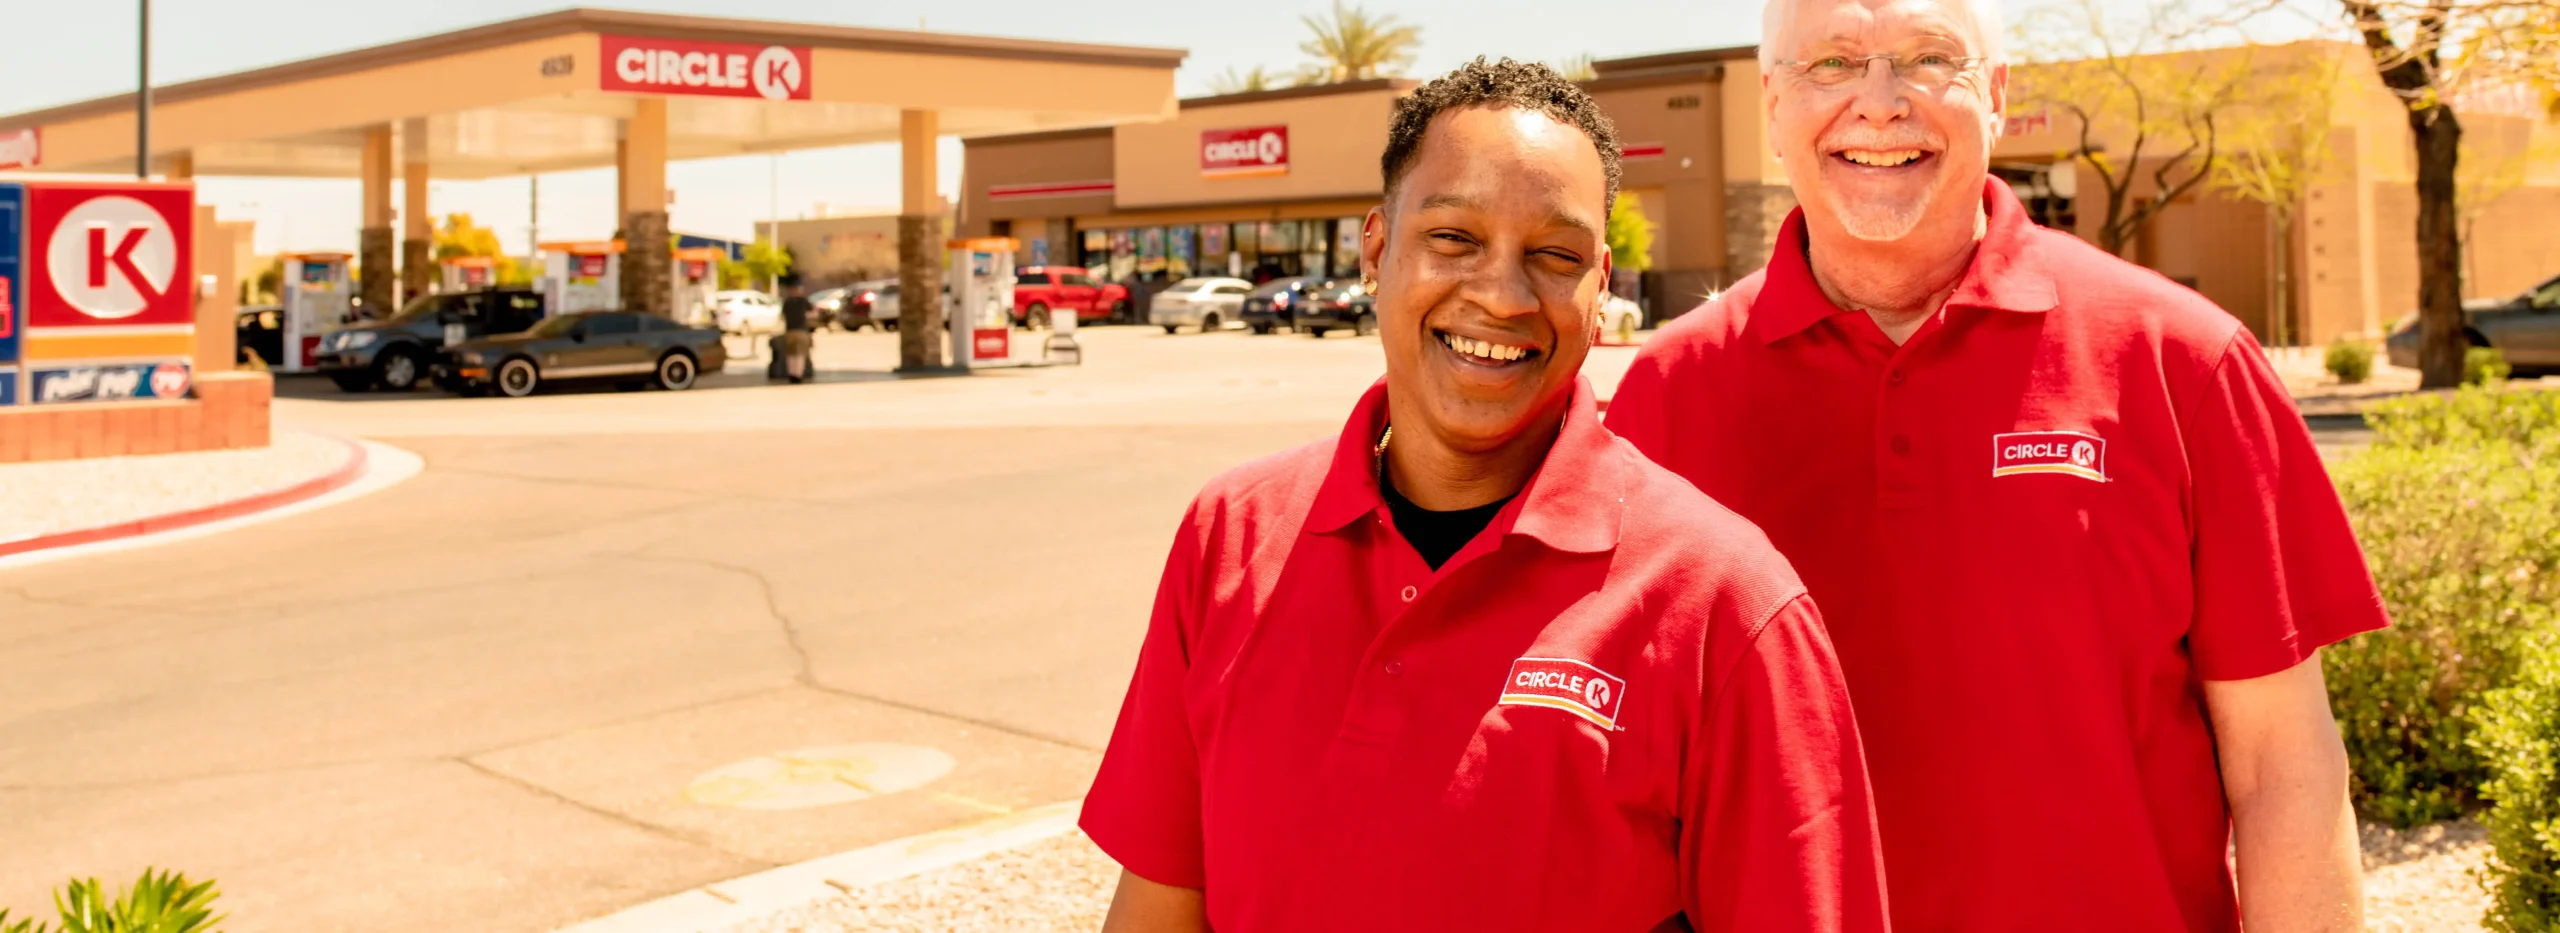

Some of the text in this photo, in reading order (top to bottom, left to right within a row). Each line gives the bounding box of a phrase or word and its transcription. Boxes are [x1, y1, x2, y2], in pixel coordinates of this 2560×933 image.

[616, 47, 748, 89] CIRCLE
[1204, 140, 1257, 162] CIRCLE
[2004, 443, 2068, 460] CIRCLE
[1515, 671, 1583, 693] CIRCLE
